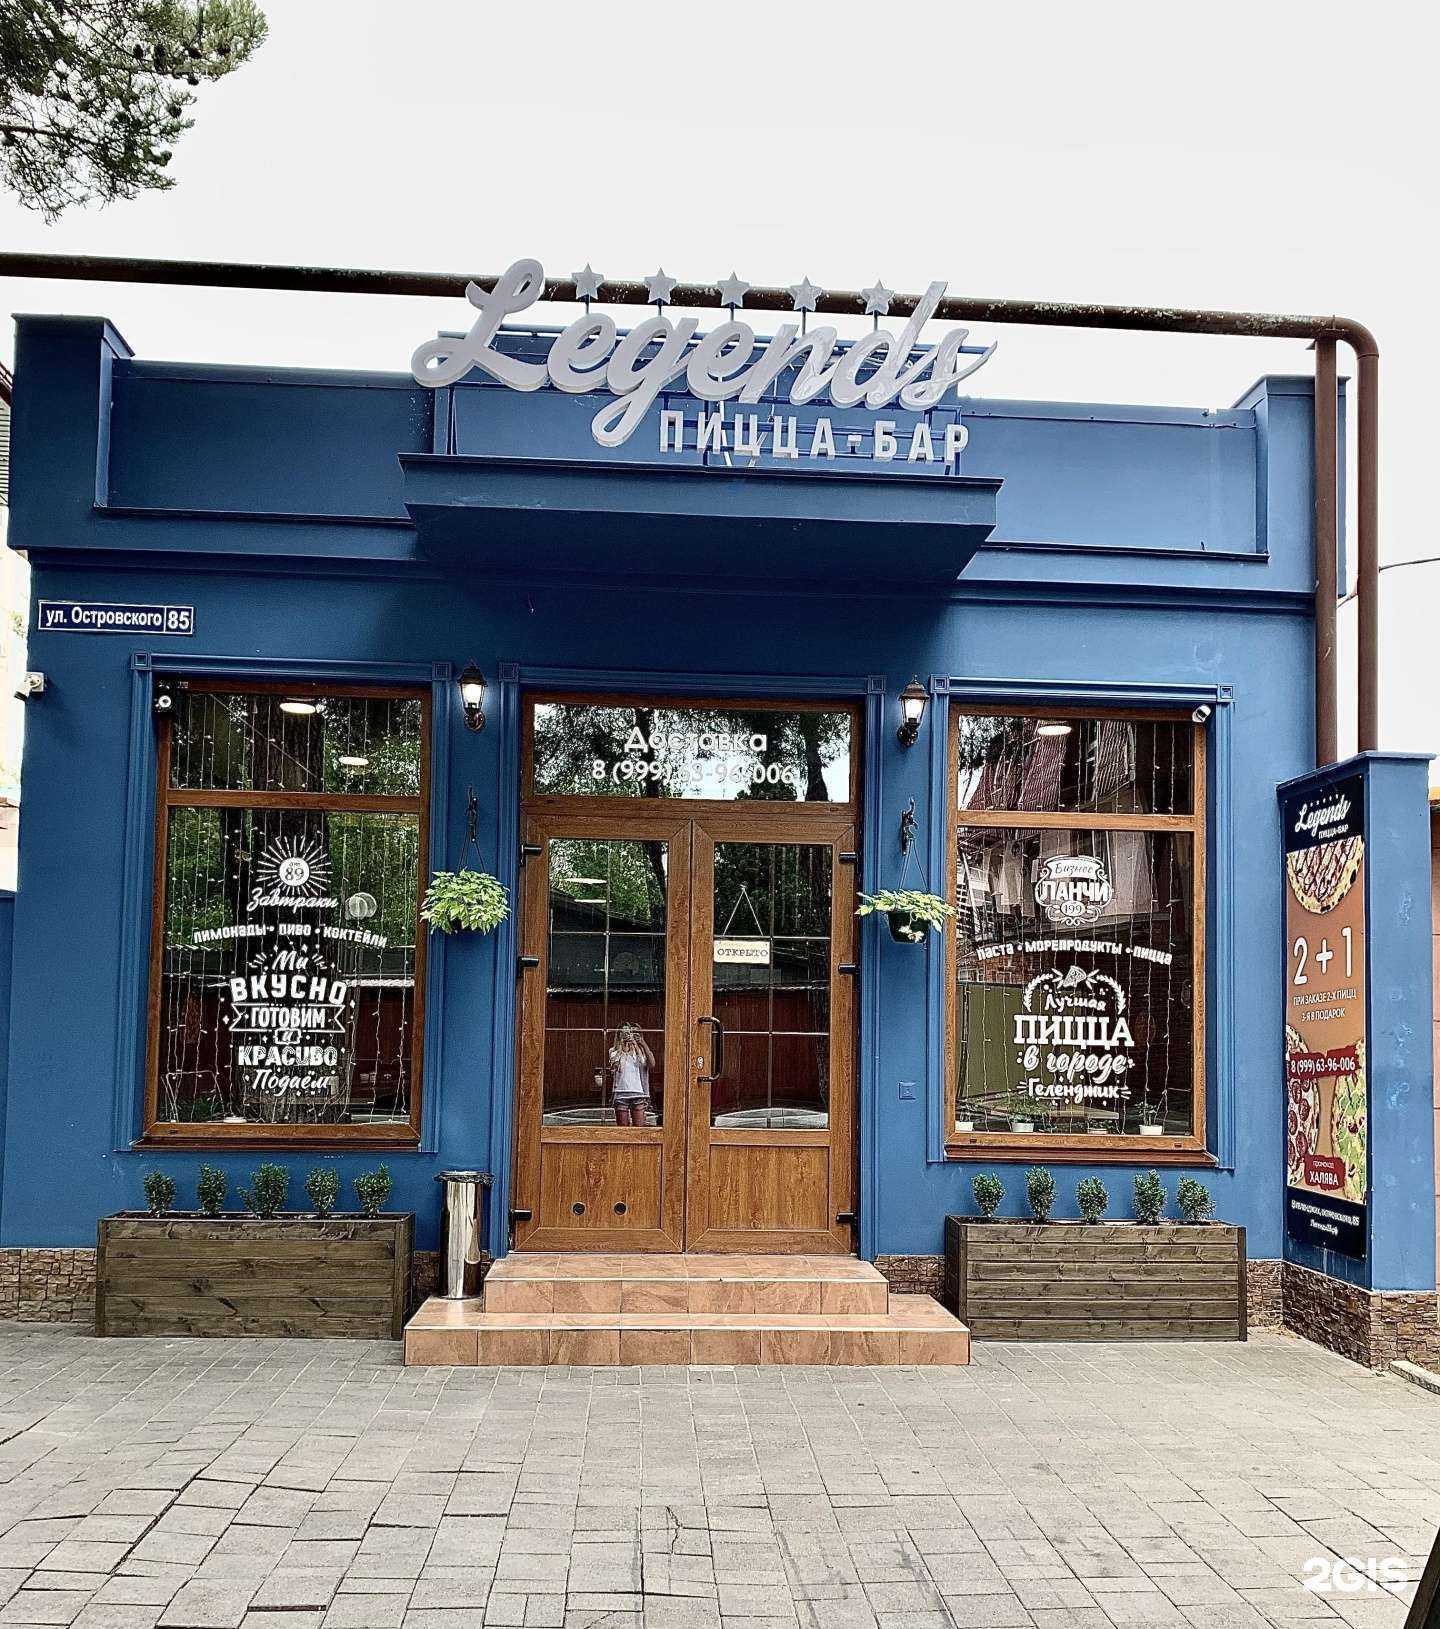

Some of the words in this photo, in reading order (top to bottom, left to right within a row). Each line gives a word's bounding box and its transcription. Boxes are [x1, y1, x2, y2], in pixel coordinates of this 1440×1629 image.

[410, 258, 998, 447] Legends
[658, 409, 969, 464] ПИЦЦА-БАР
[46, 609, 67, 626] ул.
[71, 606, 162, 628] Островского
[167, 610, 190, 630] 85
[624, 726, 767, 753] Доставка
[592, 759, 606, 780] 8
[612, 760, 674, 785] (999)
[679, 762, 794, 784] 63-96006
[1295, 794, 1351, 837] Legends
[284, 867, 305, 881] 89
[246, 887, 339, 914] Завтраки
[1040, 881, 1110, 902] ЛАНЧИ
[1064, 904, 1083, 915] 199
[717, 948, 768, 958] ОТКРЫТО
[230, 974, 347, 1004] ВКУСНО
[1045, 994, 1106, 1012] Лучшая
[1315, 1007, 1345, 1020] ПОДАРОК
[251, 1007, 326, 1028] ГОТОВИМ
[1014, 1015, 1135, 1050] ПИЦЦА
[238, 1045, 338, 1066] КРАСИВО
[1024, 1045, 1040, 1071] в
[1047, 1052, 1127, 1084] городе
[1291, 1060, 1296, 1073] 8
[1297, 1059, 1315, 1075] (999)
[1316, 1057, 1356, 1072] 63-96-006
[252, 1069, 329, 1096] Подаём
[1028, 1078, 1120, 1104] Геленджик
[1310, 1171, 1339, 1185] ХАЛЯВА
